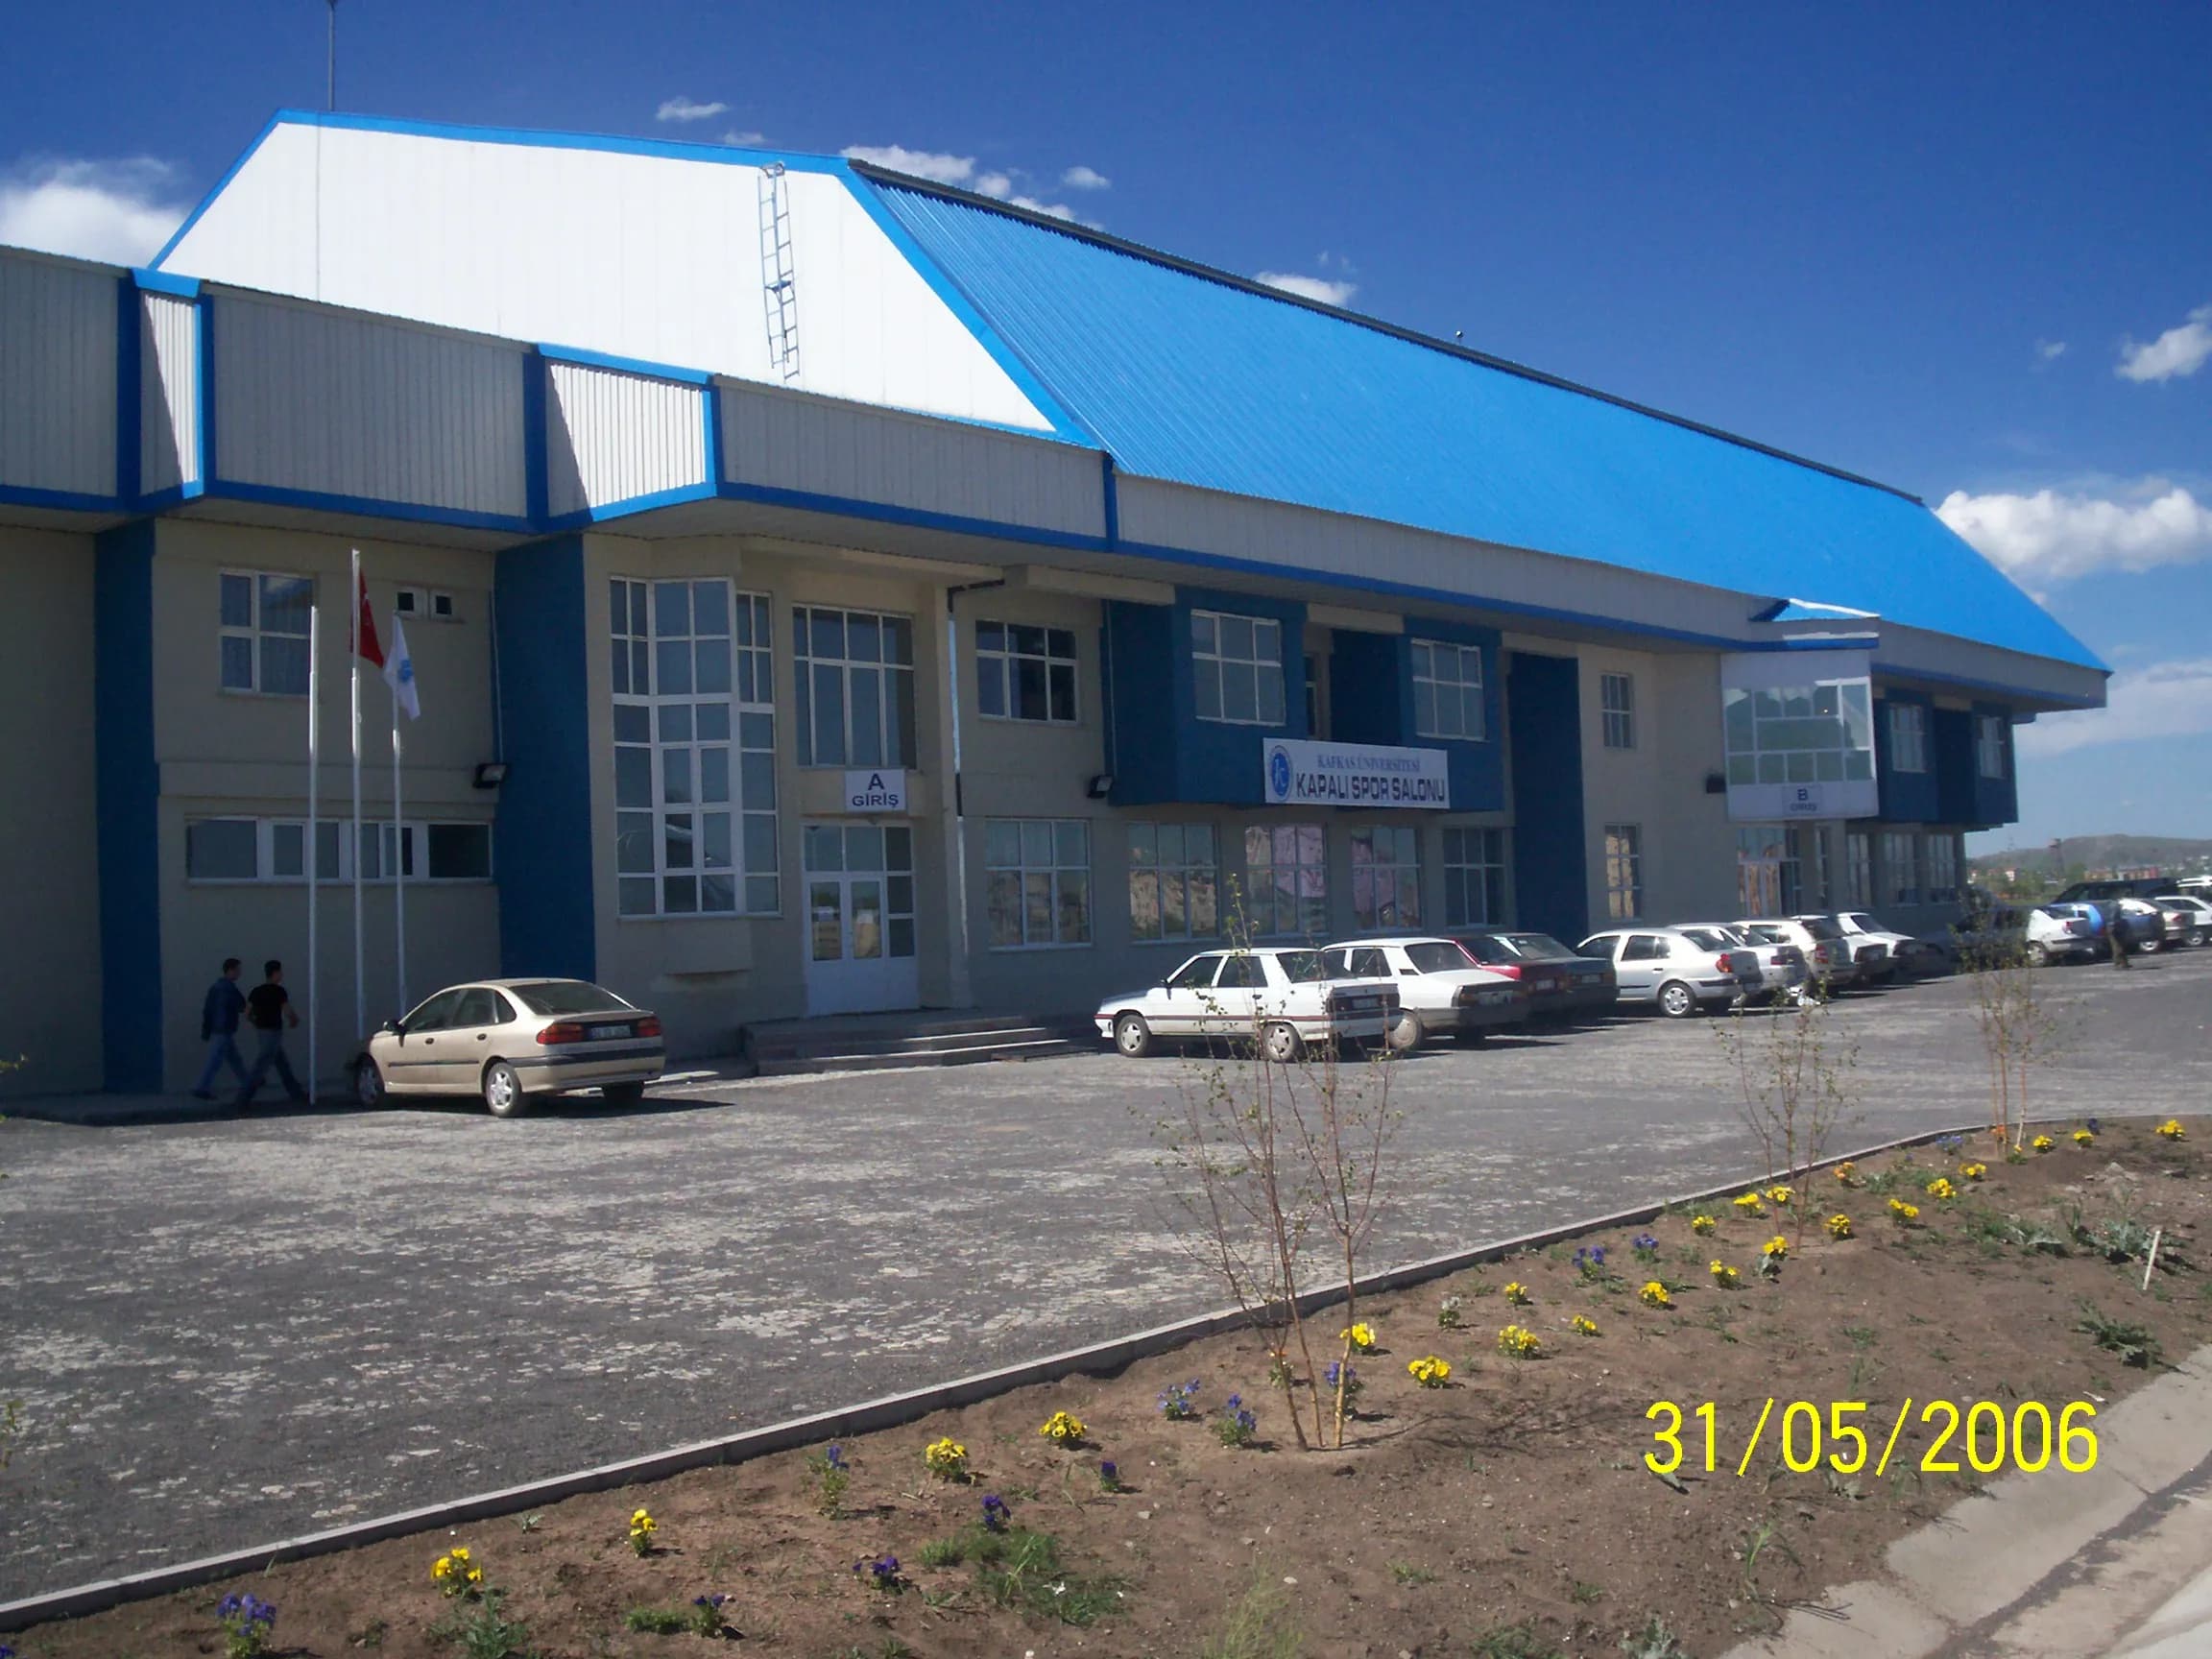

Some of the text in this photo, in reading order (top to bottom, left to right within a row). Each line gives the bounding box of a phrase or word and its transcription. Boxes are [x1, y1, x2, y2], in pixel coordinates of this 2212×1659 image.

[1317, 754, 1355, 769] KAFKAS
[867, 773, 884, 790] A
[1296, 773, 1446, 802] KAPALI SPOR SALONU
[1796, 788, 1809, 801] B
